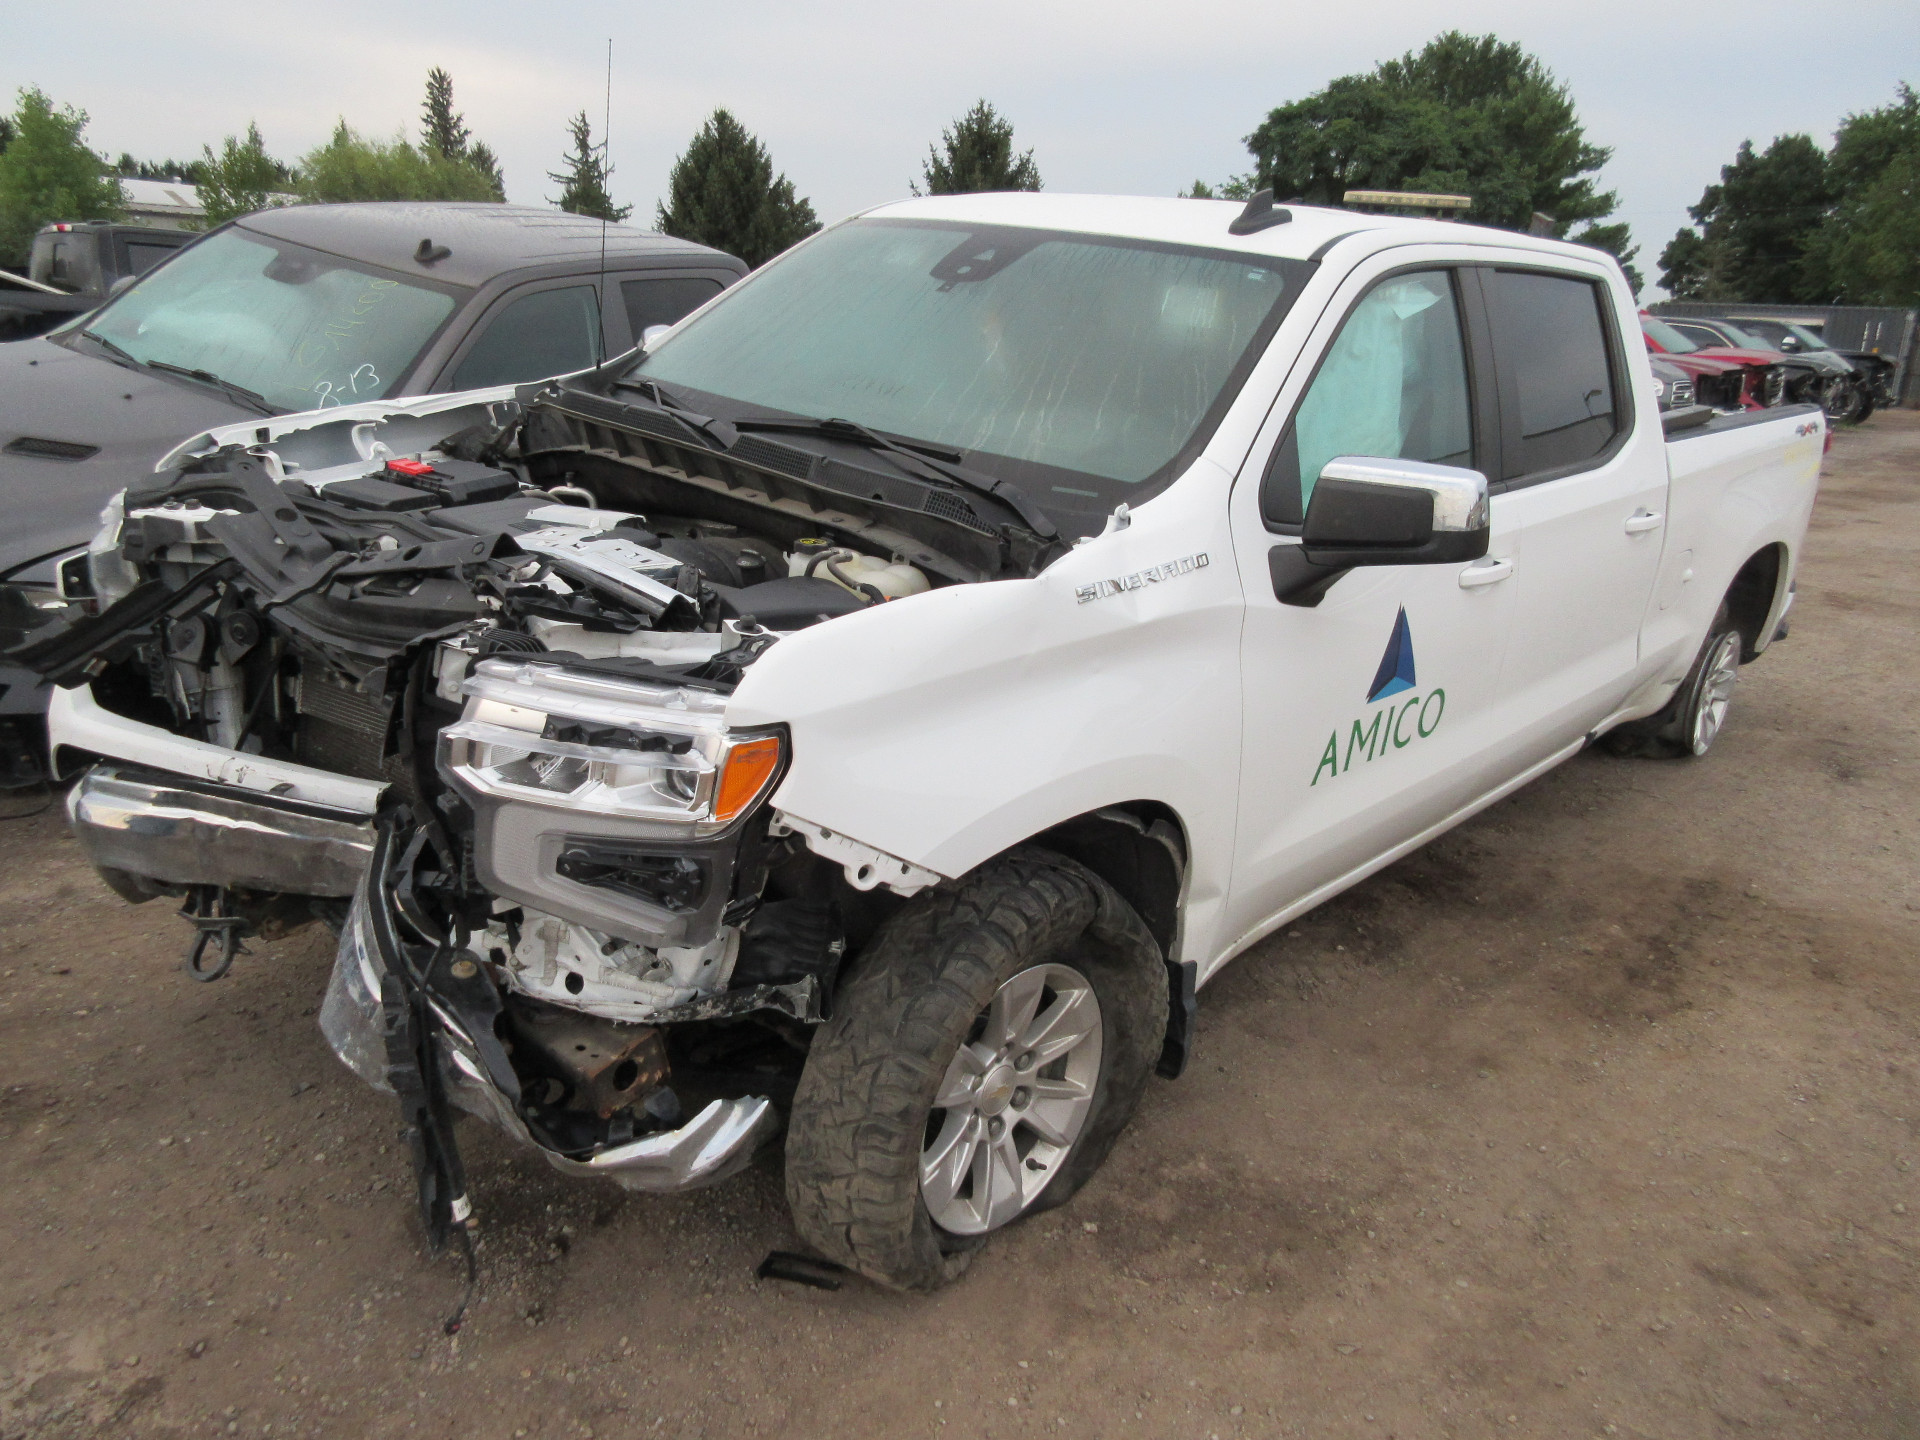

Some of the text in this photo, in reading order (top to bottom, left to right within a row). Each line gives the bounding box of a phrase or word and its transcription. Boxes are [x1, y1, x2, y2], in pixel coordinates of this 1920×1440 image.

[315, 363, 381, 410] 8-13
[1075, 552, 1209, 605] SILVERADO
[1310, 688, 1445, 787] AMICO
